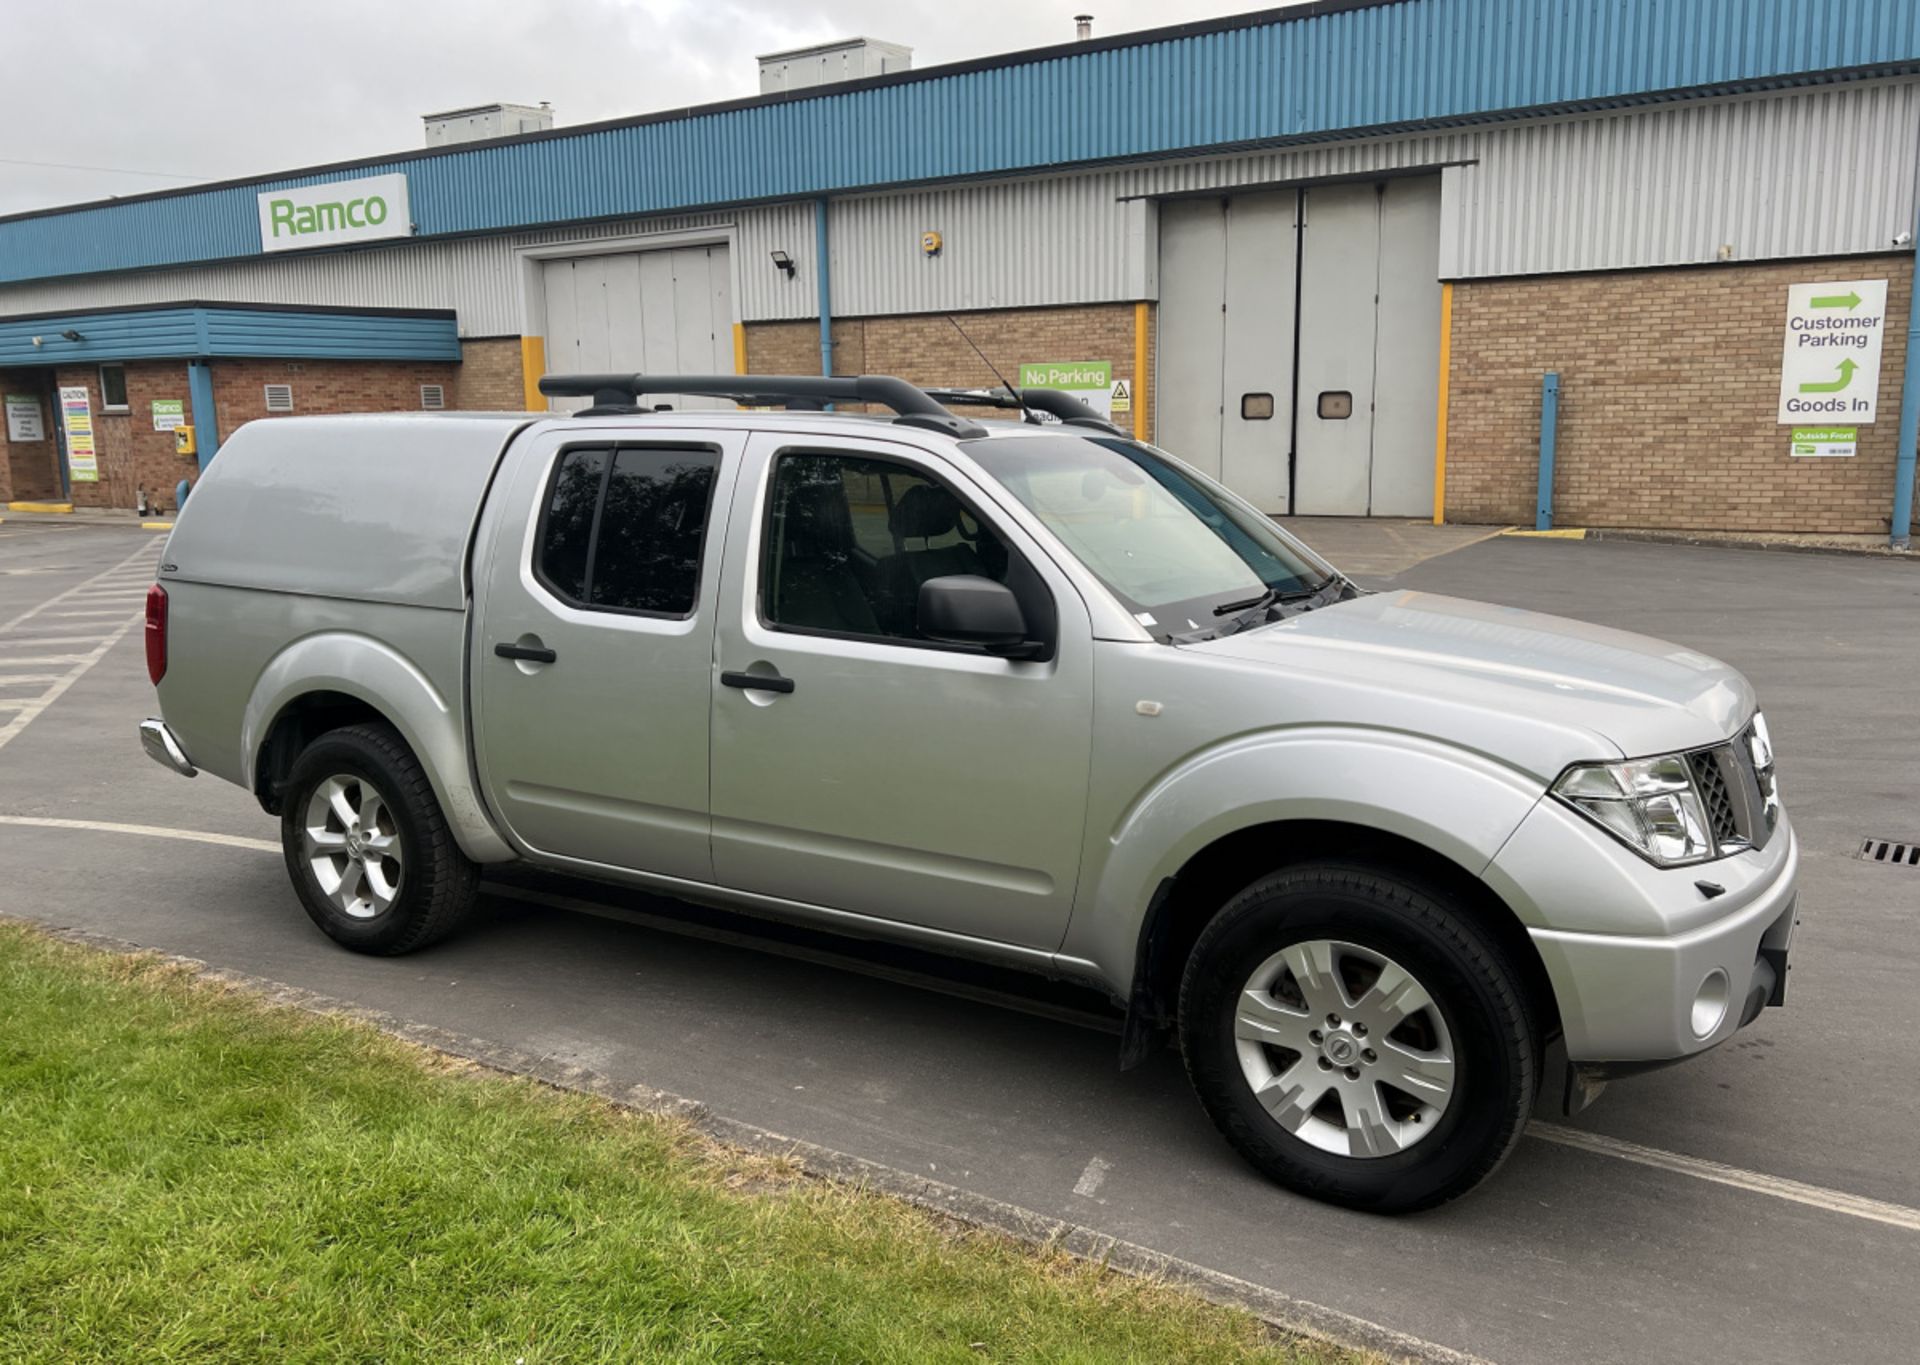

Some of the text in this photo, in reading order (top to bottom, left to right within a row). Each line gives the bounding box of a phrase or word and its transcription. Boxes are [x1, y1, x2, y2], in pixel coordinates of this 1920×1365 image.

[270, 195, 387, 238] Ramco
[1790, 316, 1880, 331] Customer
[1798, 332, 1868, 349] Parking
[1026, 368, 1105, 386] No Parking
[1786, 397, 1869, 412] Goods In
[1794, 431, 1855, 440] Outside Front
